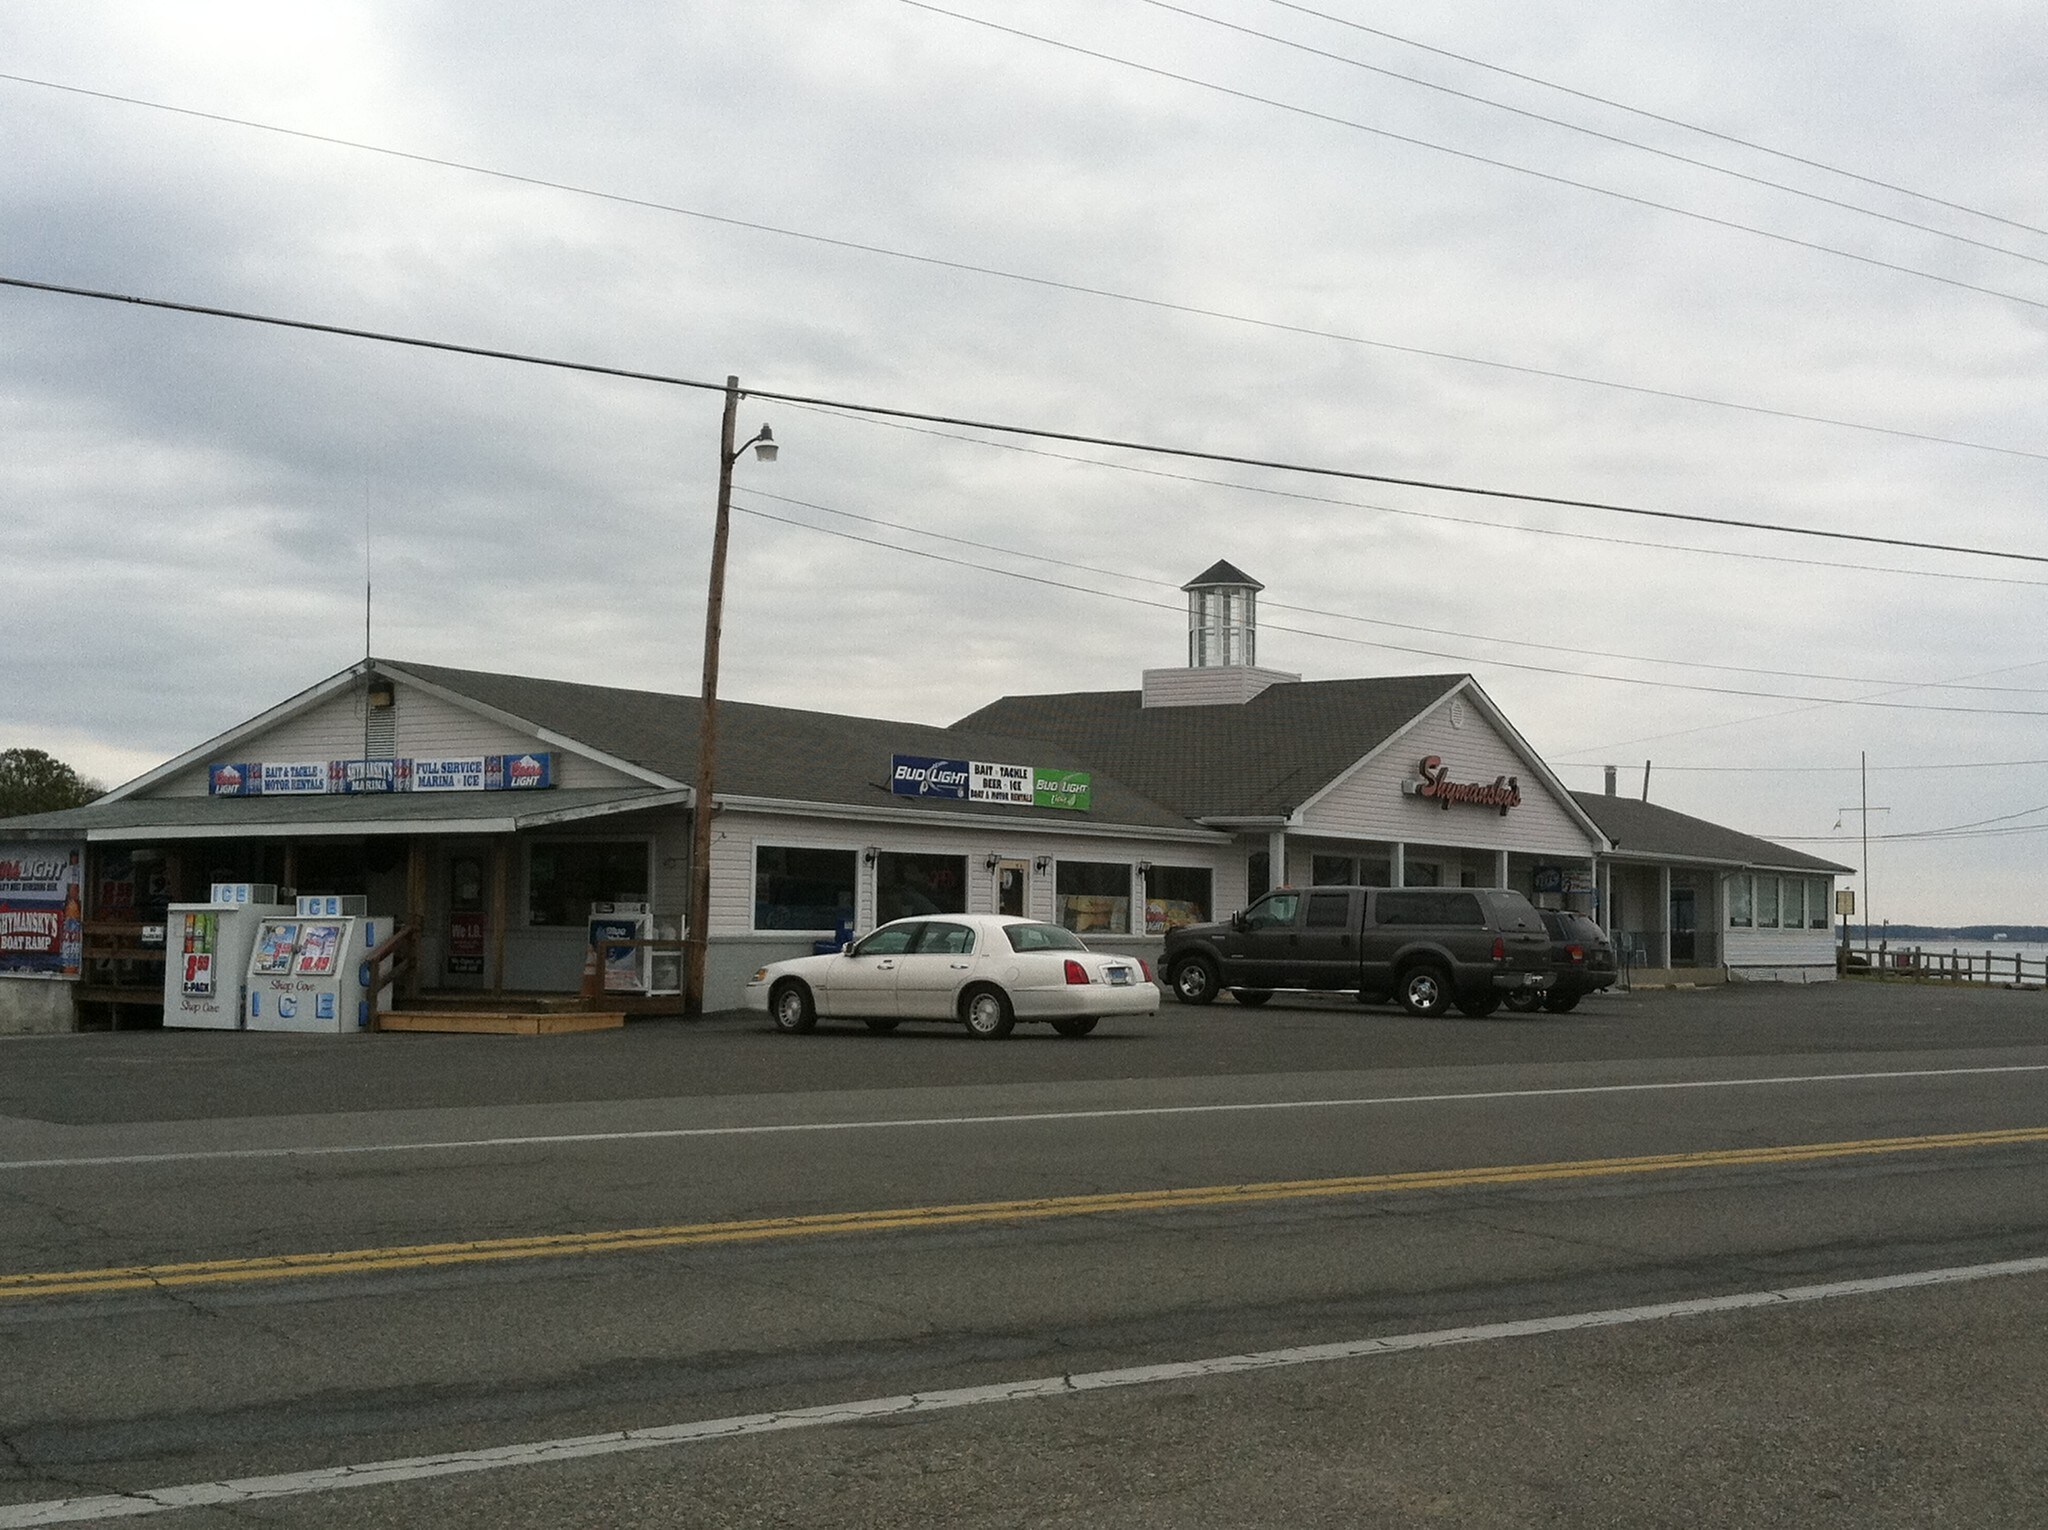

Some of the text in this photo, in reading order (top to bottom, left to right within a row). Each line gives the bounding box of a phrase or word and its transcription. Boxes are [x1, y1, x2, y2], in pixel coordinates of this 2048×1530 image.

[265, 766, 318, 778] BAIT & TACKLE
[416, 762, 440, 775] FULL
[441, 761, 482, 774] SERVICE
[894, 765, 968, 784] BUD LIGHT
[974, 764, 1028, 779] BAIT TACKLE
[265, 779, 324, 791] MOTOR RENTALS
[351, 780, 387, 791] MARINA
[418, 774, 479, 787] MARINA ICE
[511, 776, 539, 787] LIGHT
[983, 778, 1022, 791] BEER ICE
[1036, 779, 1088, 793] BUD LIGHT
[215, 784, 240, 794] LIGHT
[991, 791, 1009, 801] MOTOR
[1010, 792, 1033, 803] RENTALS
[20, 861, 67, 879] LIGHT
[213, 885, 247, 902] ICE
[299, 897, 338, 915] ICE
[1, 935, 23, 950] BOAT
[25, 936, 51, 951] RAMP
[184, 982, 210, 993] 6-PACK
[270, 980, 294, 992] Shop
[252, 991, 335, 1019] ICE
